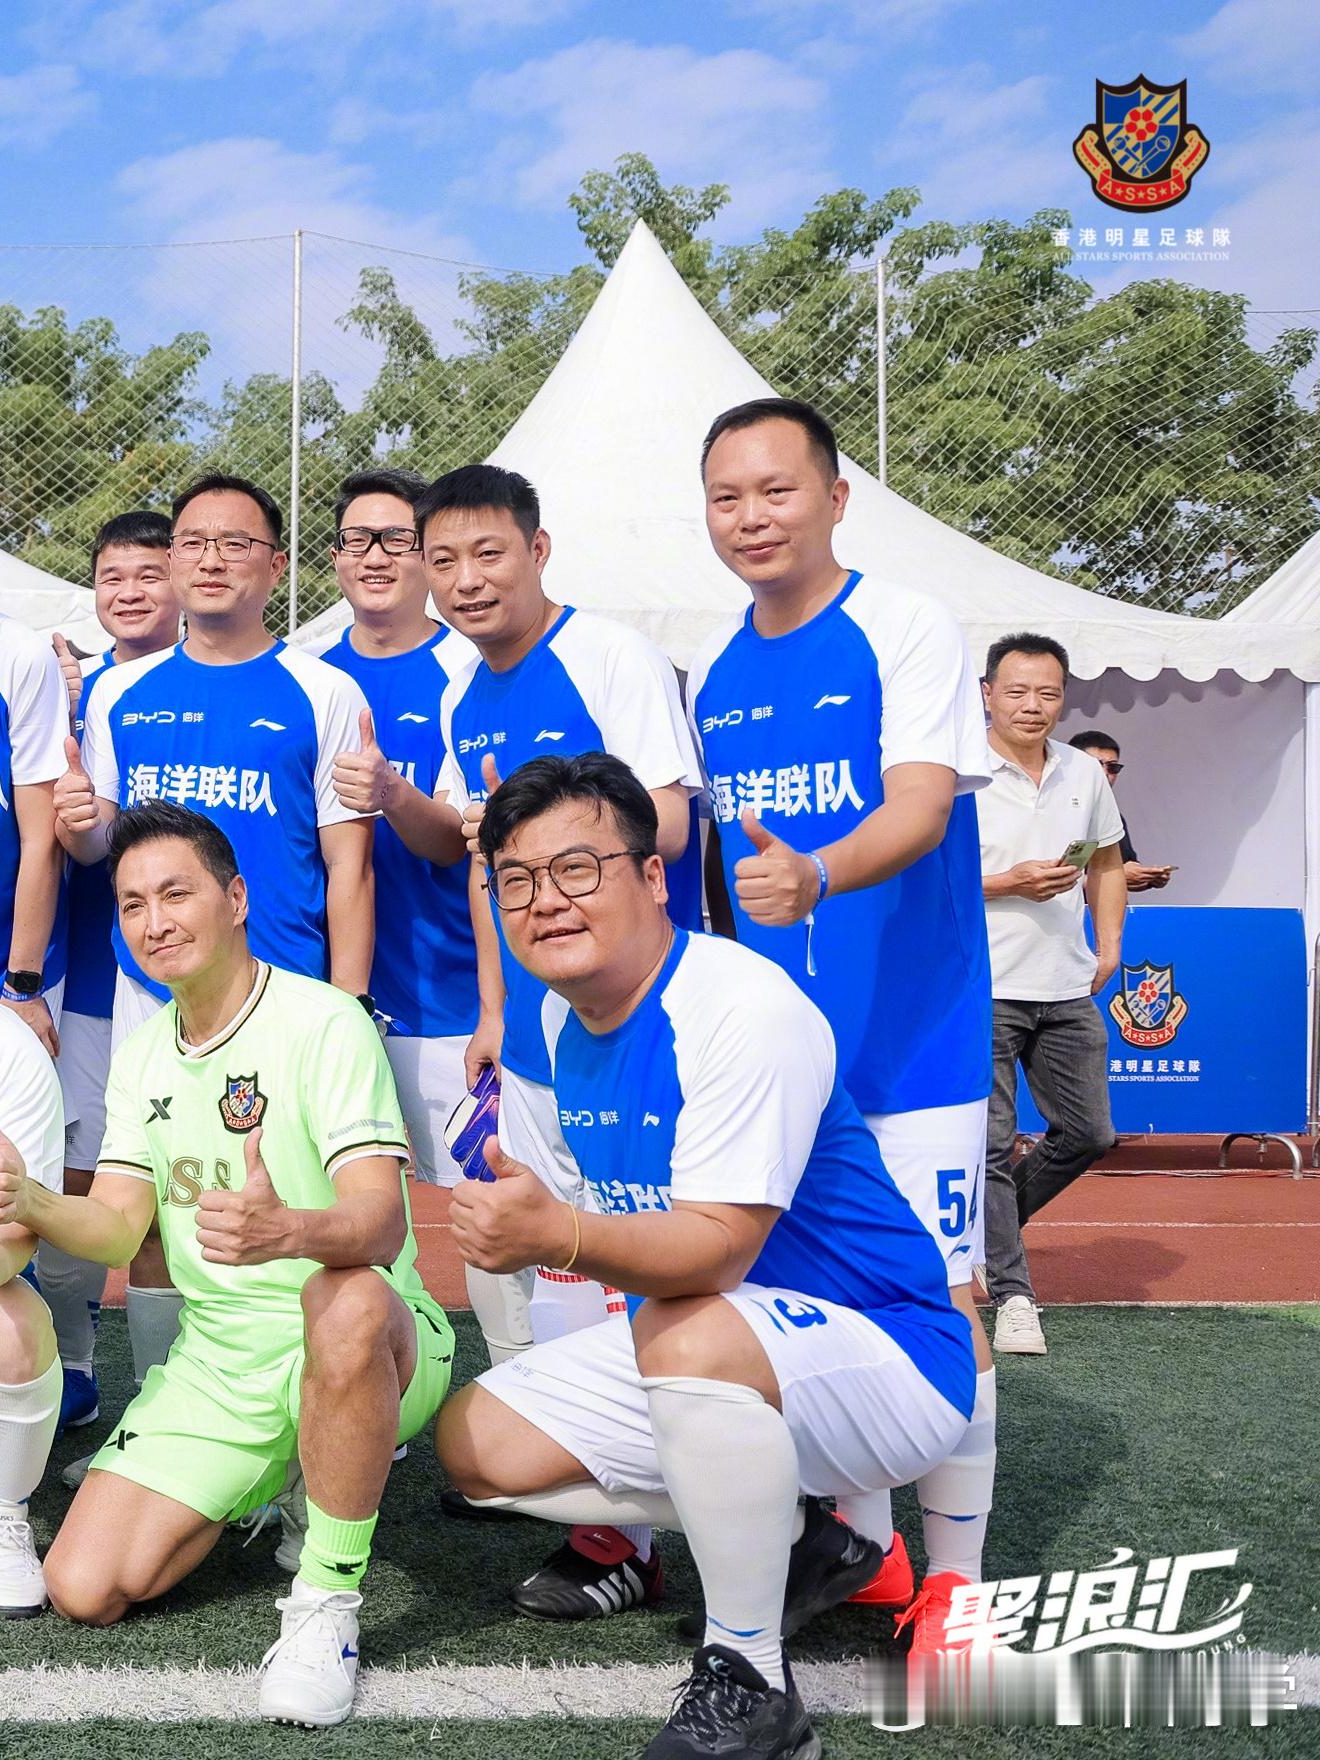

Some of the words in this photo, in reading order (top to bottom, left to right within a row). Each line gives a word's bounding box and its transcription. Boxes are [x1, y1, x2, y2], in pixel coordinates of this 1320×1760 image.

[122, 710, 176, 726] BYD
[182, 711, 204, 723] 海洋
[702, 709, 744, 733] BYD
[751, 705, 774, 721] 海洋
[127, 763, 278, 817] 海洋联队
[709, 759, 865, 824] 海洋联队
[560, 1110, 594, 1126] BYD
